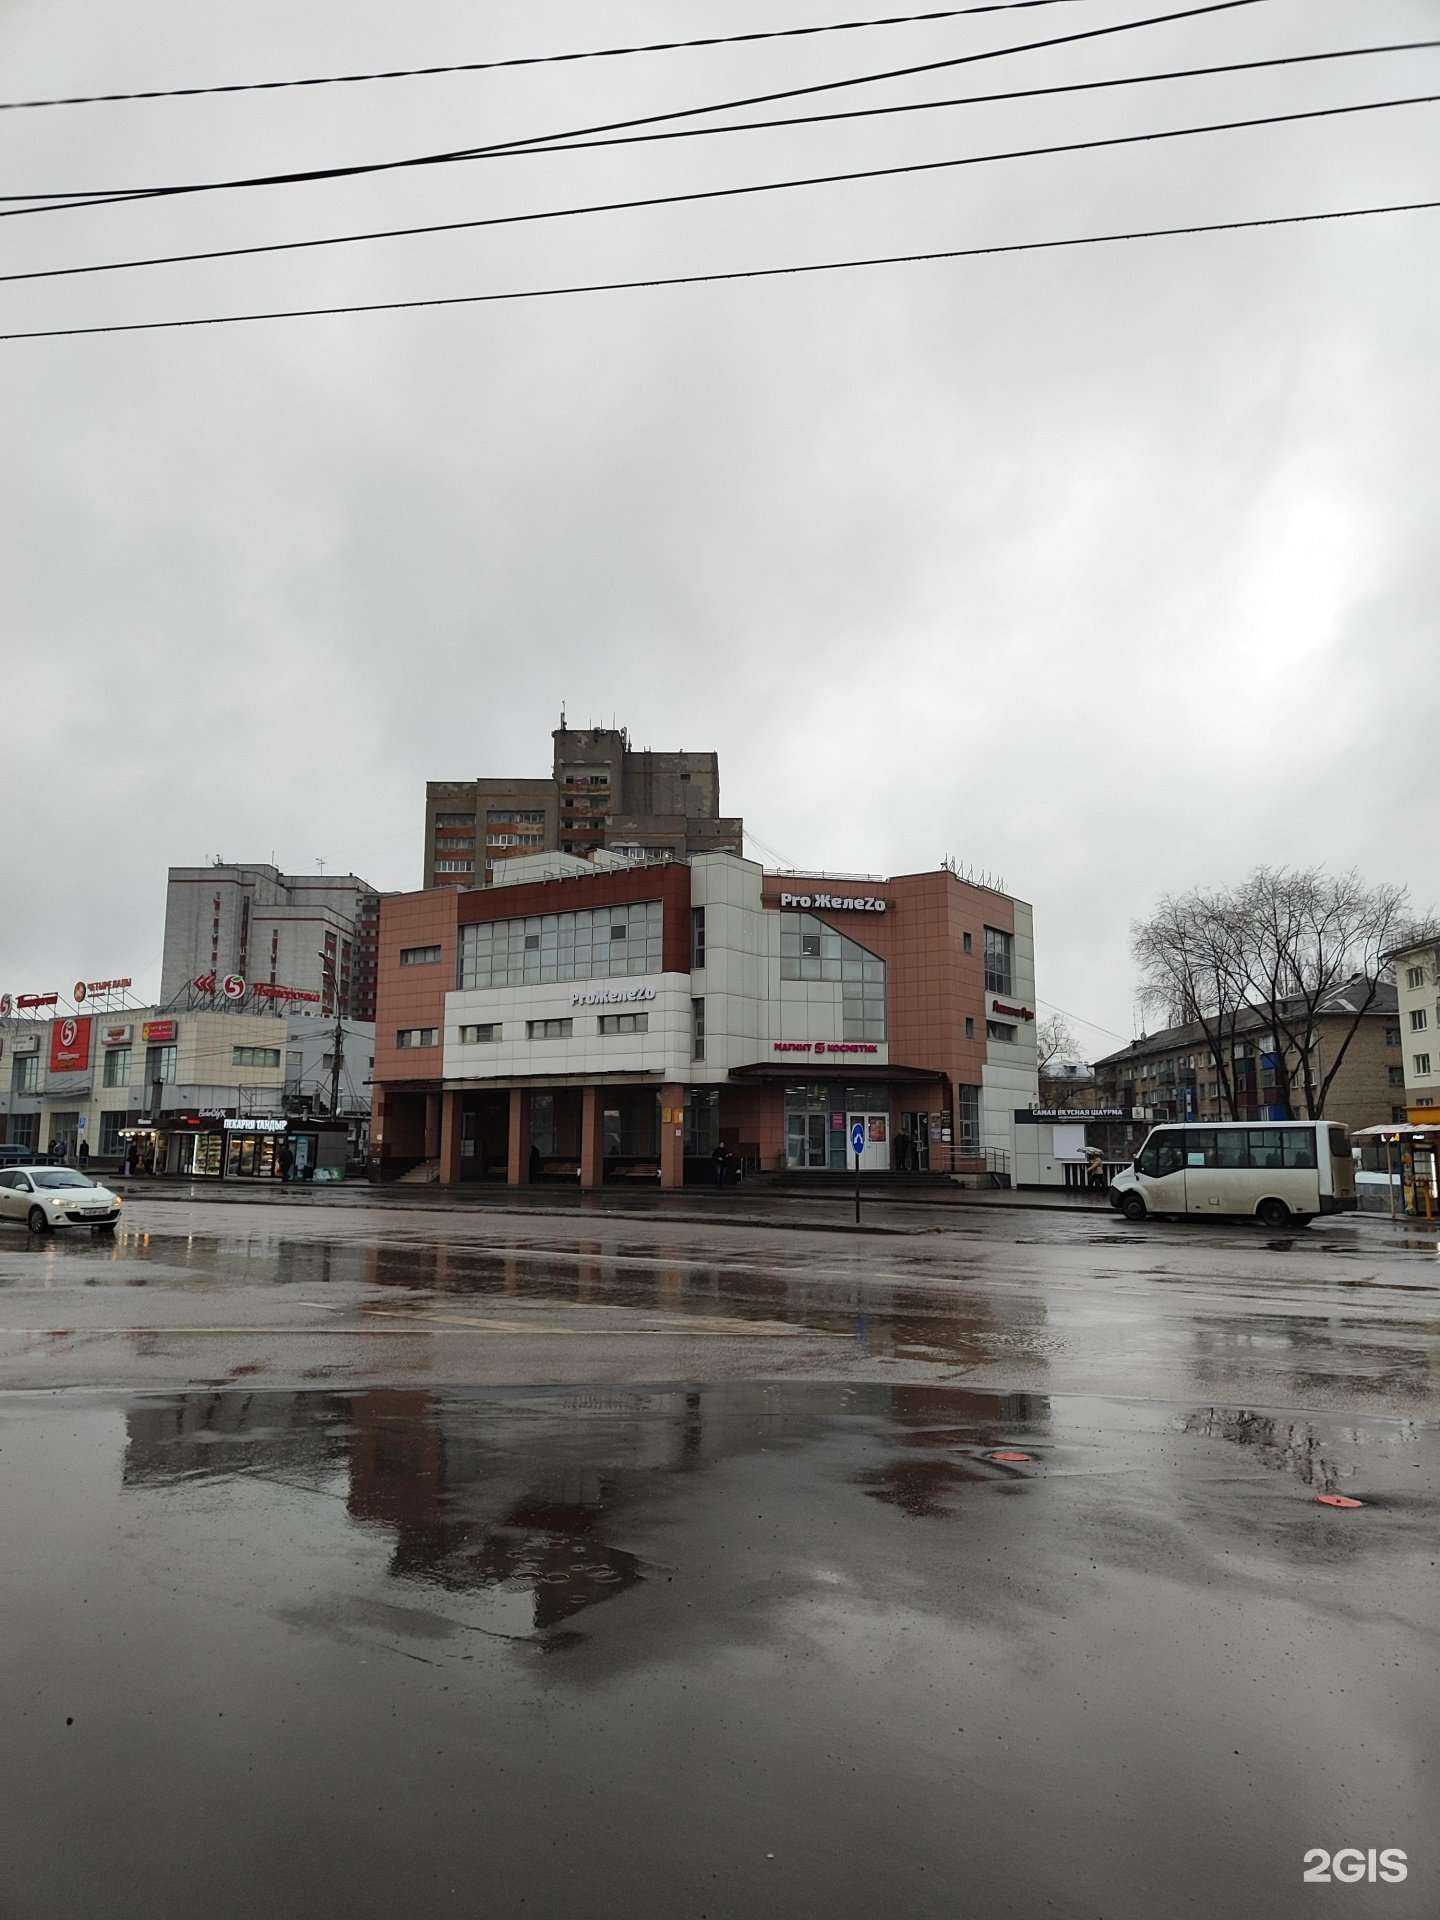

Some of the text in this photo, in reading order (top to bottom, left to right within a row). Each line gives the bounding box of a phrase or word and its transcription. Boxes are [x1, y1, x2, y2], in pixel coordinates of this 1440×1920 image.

[781, 893, 811, 908] Pro
[774, 1043, 878, 1053] МАГНИТ КОСМЕТИК
[223, 1119, 288, 1132] ПЕКАРНЯ ТАНДЫР
